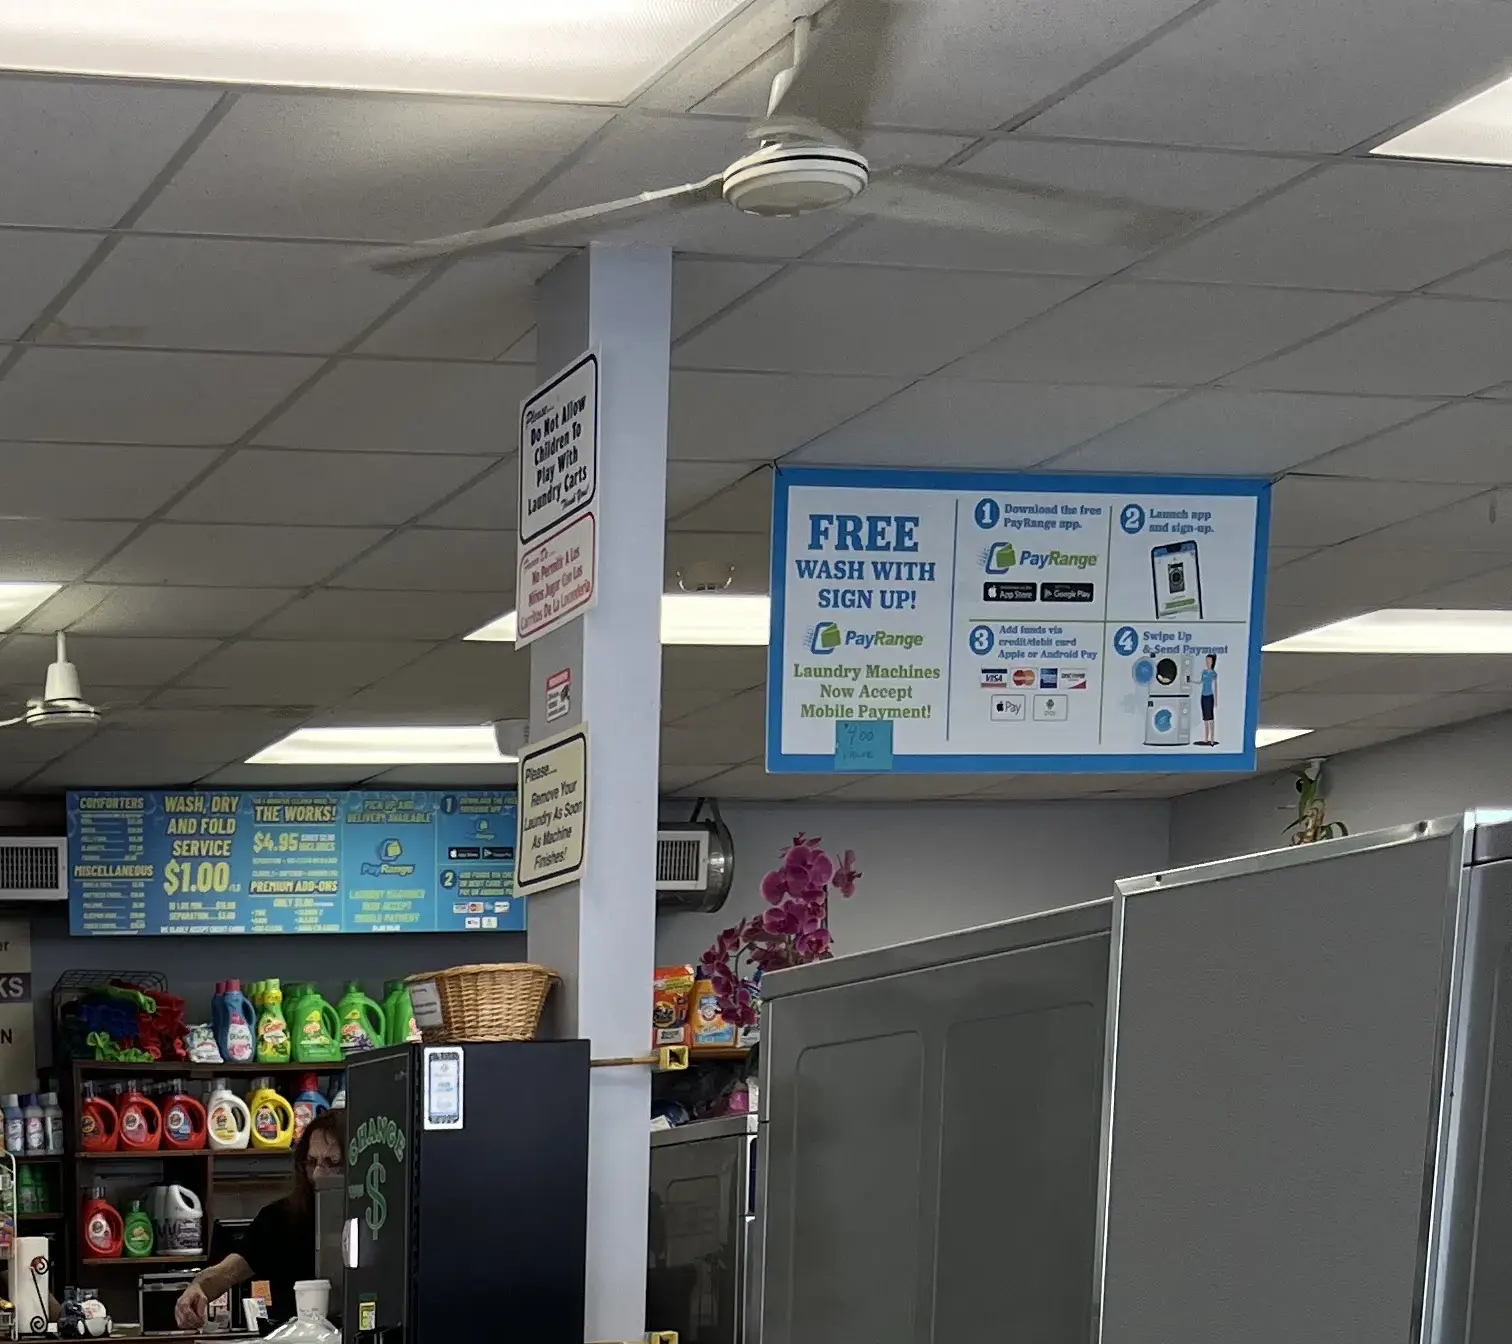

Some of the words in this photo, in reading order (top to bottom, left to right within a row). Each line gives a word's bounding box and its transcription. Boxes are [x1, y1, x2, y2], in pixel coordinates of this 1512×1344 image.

[531, 428, 541, 446] Do
[544, 413, 559, 438] Not
[562, 395, 586, 425] Allow
[534, 432, 569, 466] Children
[572, 421, 581, 440] To
[537, 464, 555, 488] Play
[558, 445, 578, 473] With
[528, 482, 561, 516] Laundry
[564, 465, 587, 492] Carts
[982, 502, 992, 524] 1
[1004, 503, 1058, 515] Download
[1060, 505, 1077, 515] the
[1080, 505, 1101, 516] free
[1124, 507, 1139, 529] 2
[1149, 508, 1188, 519] Launch
[1191, 510, 1211, 522] app
[808, 514, 920, 552] FREE
[1003, 518, 1057, 530] PayRange
[1059, 520, 1082, 530] app.
[1149, 523, 1168, 532] and
[1171, 522, 1214, 535] sign-up.
[1019, 550, 1097, 569] PayRange
[795, 559, 864, 580] WASH
[871, 561, 936, 581] WITH
[817, 588, 872, 610] SIGN
[879, 589, 916, 610] UP!
[999, 591, 1014, 599] App
[1015, 590, 1033, 599] Store
[1053, 590, 1076, 600] Google
[1077, 590, 1091, 599] Play
[844, 630, 923, 649] PayRange
[974, 628, 988, 650] 3
[999, 625, 1018, 634] Add
[1020, 625, 1046, 634] funds
[1048, 626, 1063, 634] via
[998, 638, 1053, 647] credit/debit
[1055, 638, 1077, 646] card
[1117, 630, 1134, 651] 4
[1143, 631, 1175, 643] Swipe
[1178, 631, 1192, 643] Up
[997, 650, 1026, 660] Apple
[1040, 650, 1078, 659] Android
[1081, 650, 1098, 660] Pay
[1154, 645, 1180, 654] Send
[1183, 645, 1229, 656] Payment
[793, 663, 861, 682] Laundry
[865, 664, 940, 679] Machines
[985, 674, 1003, 682] VISA
[820, 684, 855, 698] Now
[858, 684, 913, 701] Accept
[800, 703, 854, 718] Mobile
[857, 703, 931, 721] Payment!
[1005, 701, 1022, 716] Pay
[531, 787, 560, 808] Remove
[561, 780, 578, 797] Your
[164, 796, 206, 814] WASH,
[211, 796, 239, 813] DRY
[255, 805, 280, 821] THE
[284, 805, 337, 821] WORKS!
[523, 811, 553, 831] Laundry
[553, 806, 563, 820] As
[564, 801, 583, 818] Soon
[167, 818, 197, 835] AND
[199, 818, 236, 835] FOLD
[253, 831, 299, 853] $4.95
[531, 835, 541, 850] As
[543, 825, 572, 846] Machine
[172, 840, 232, 856] SERVICE
[74, 865, 154, 877] MISCELLANEOUS
[163, 858, 230, 896] $1.00
[444, 872, 454, 886] 2
[250, 881, 294, 893] PREMIUM
[295, 880, 338, 893] ADD-ONS
[348, 1116, 406, 1166] CHANGE
